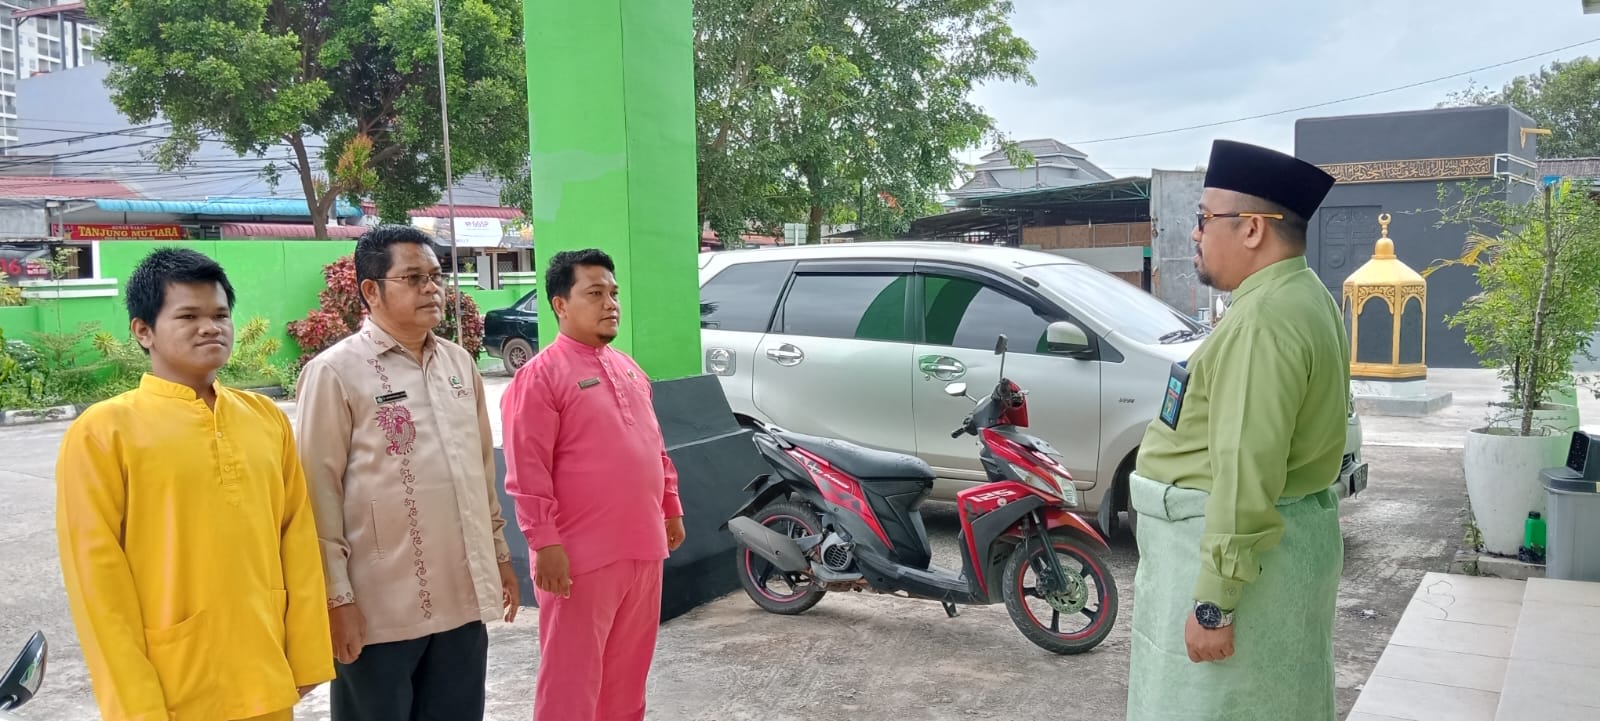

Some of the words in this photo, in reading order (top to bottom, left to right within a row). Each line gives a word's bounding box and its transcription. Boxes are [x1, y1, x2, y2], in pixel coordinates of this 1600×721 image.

[78, 225, 128, 237] TANJUNG
[132, 226, 178, 237] MUTIARA
[967, 489, 1016, 502] 125
